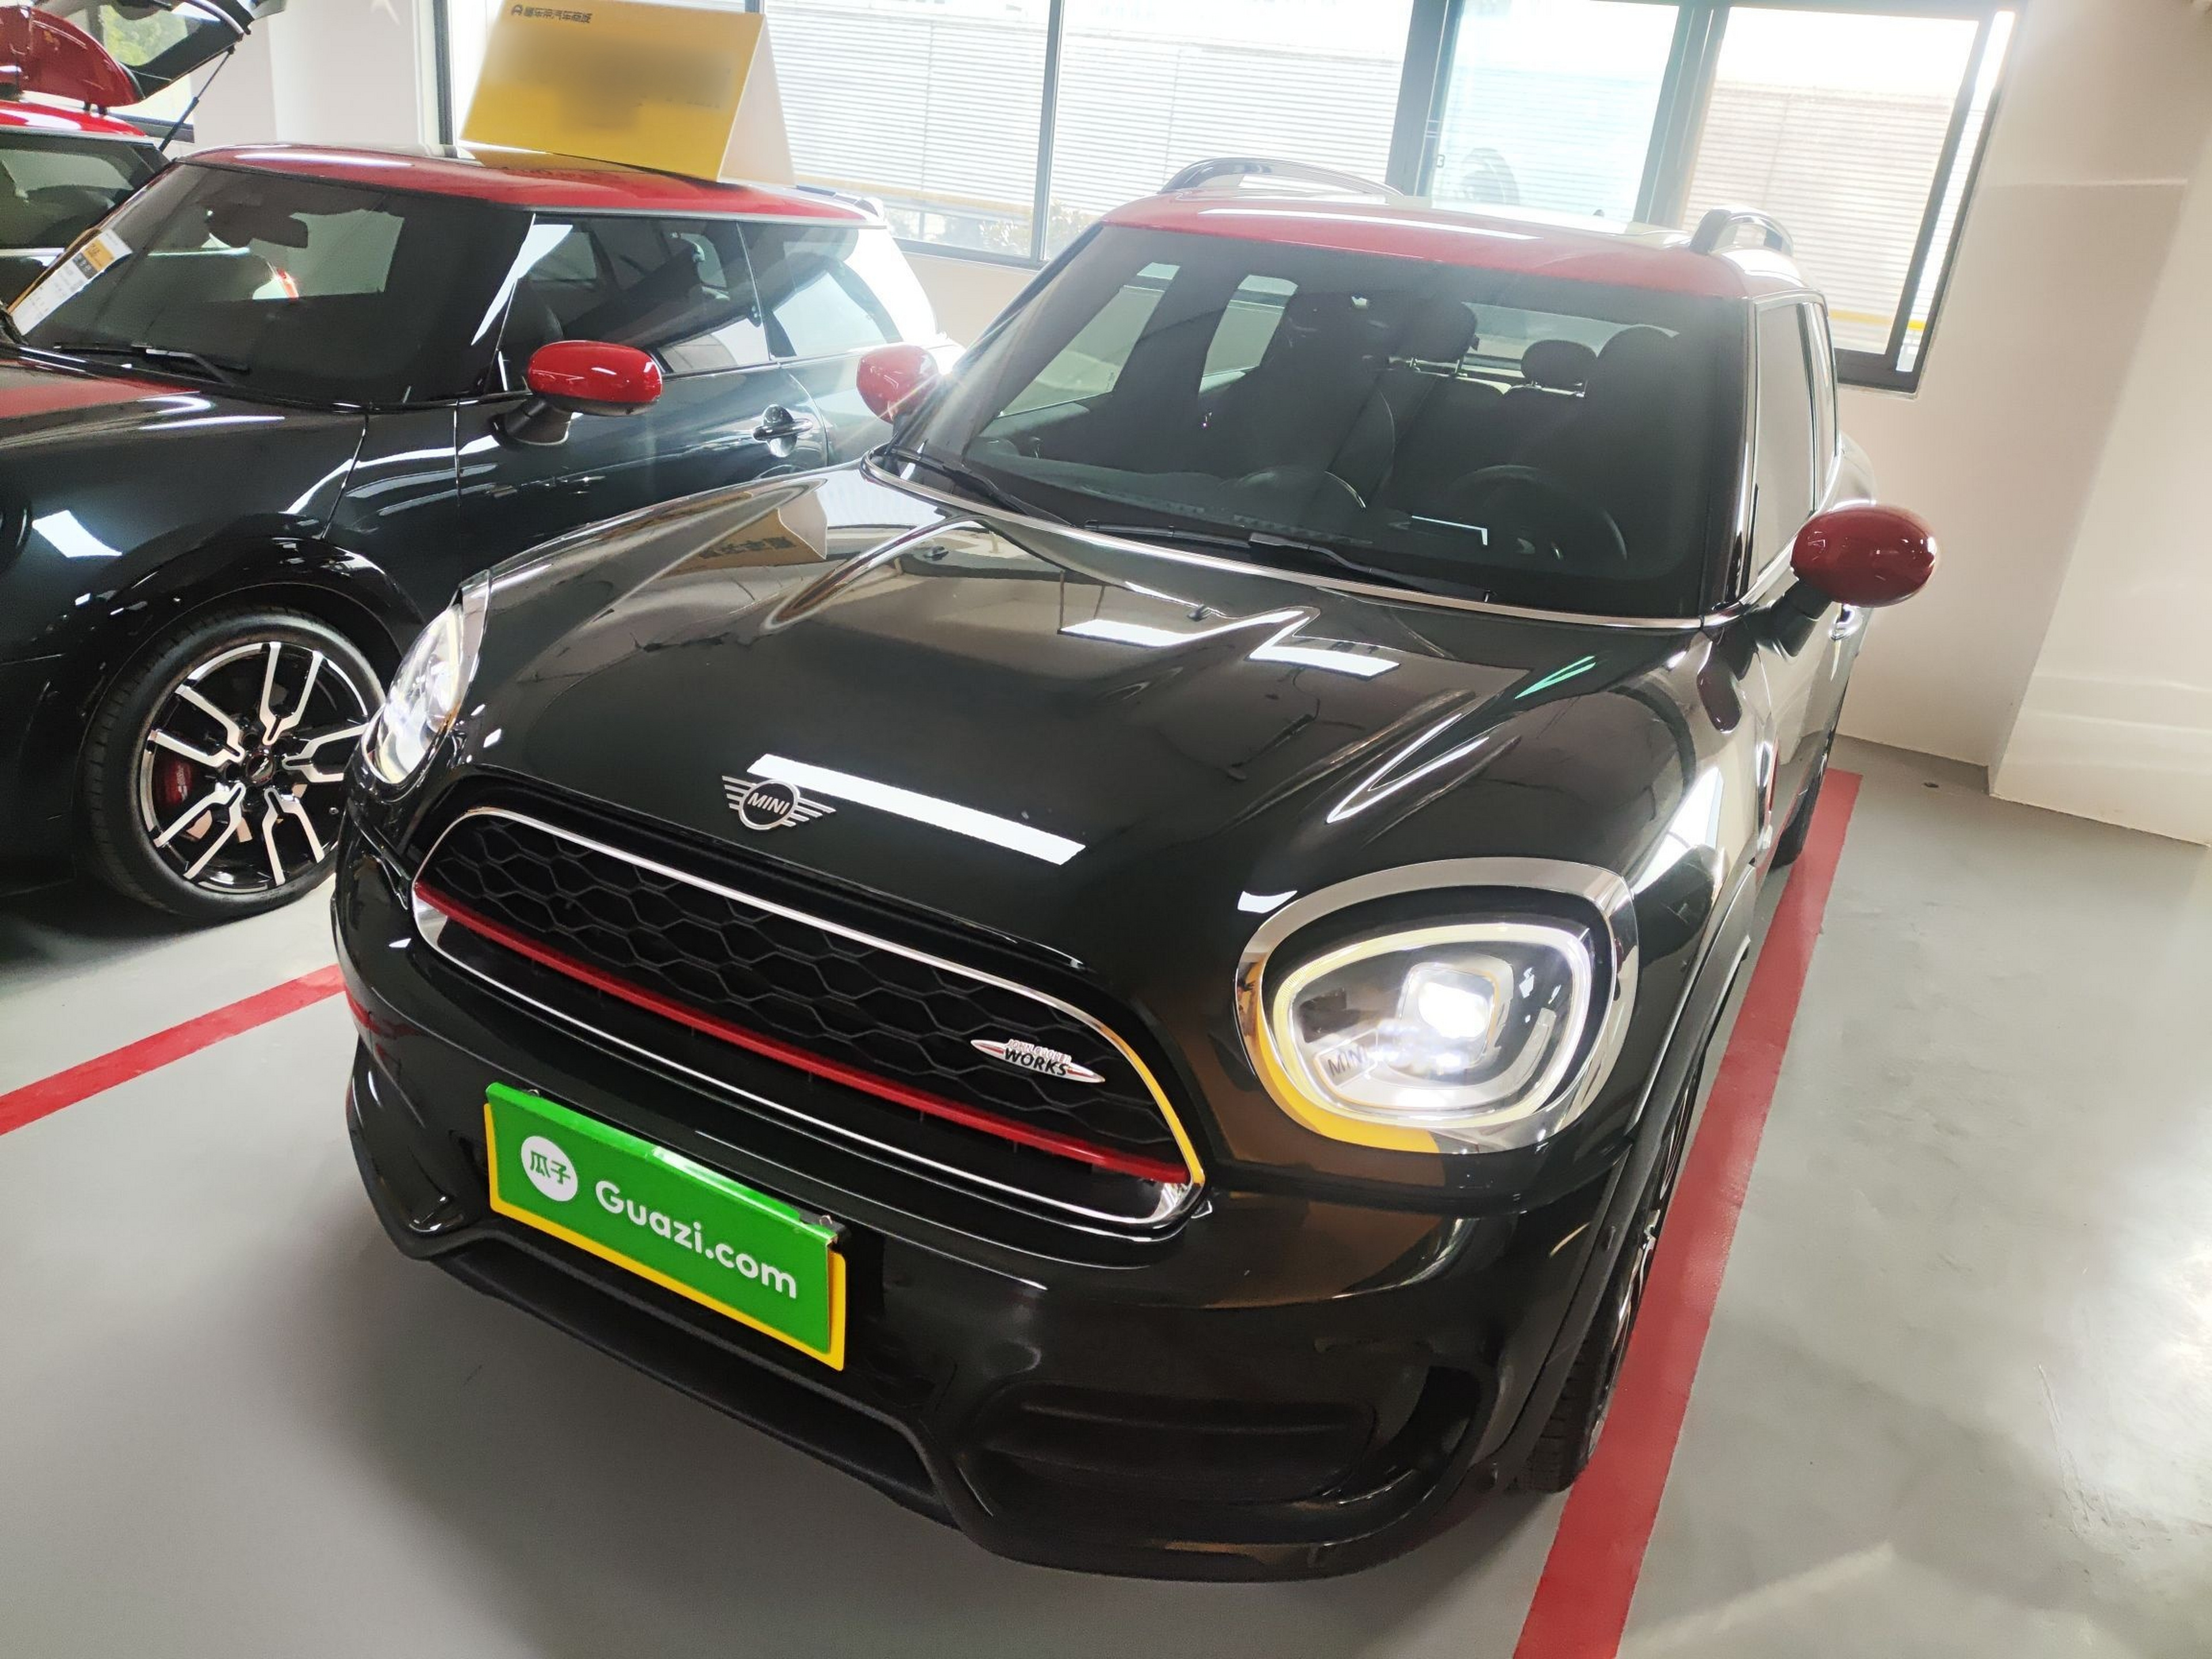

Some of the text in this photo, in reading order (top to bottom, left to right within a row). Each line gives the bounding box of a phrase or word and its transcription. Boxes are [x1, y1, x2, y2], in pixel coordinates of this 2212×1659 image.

[747, 792, 790, 815] MINI
[1005, 1048, 1069, 1075] WORKS
[1327, 1043, 1368, 1076] MINI
[529, 1150, 571, 1185] 瓜子
[596, 1180, 797, 1299] Guazi.com
